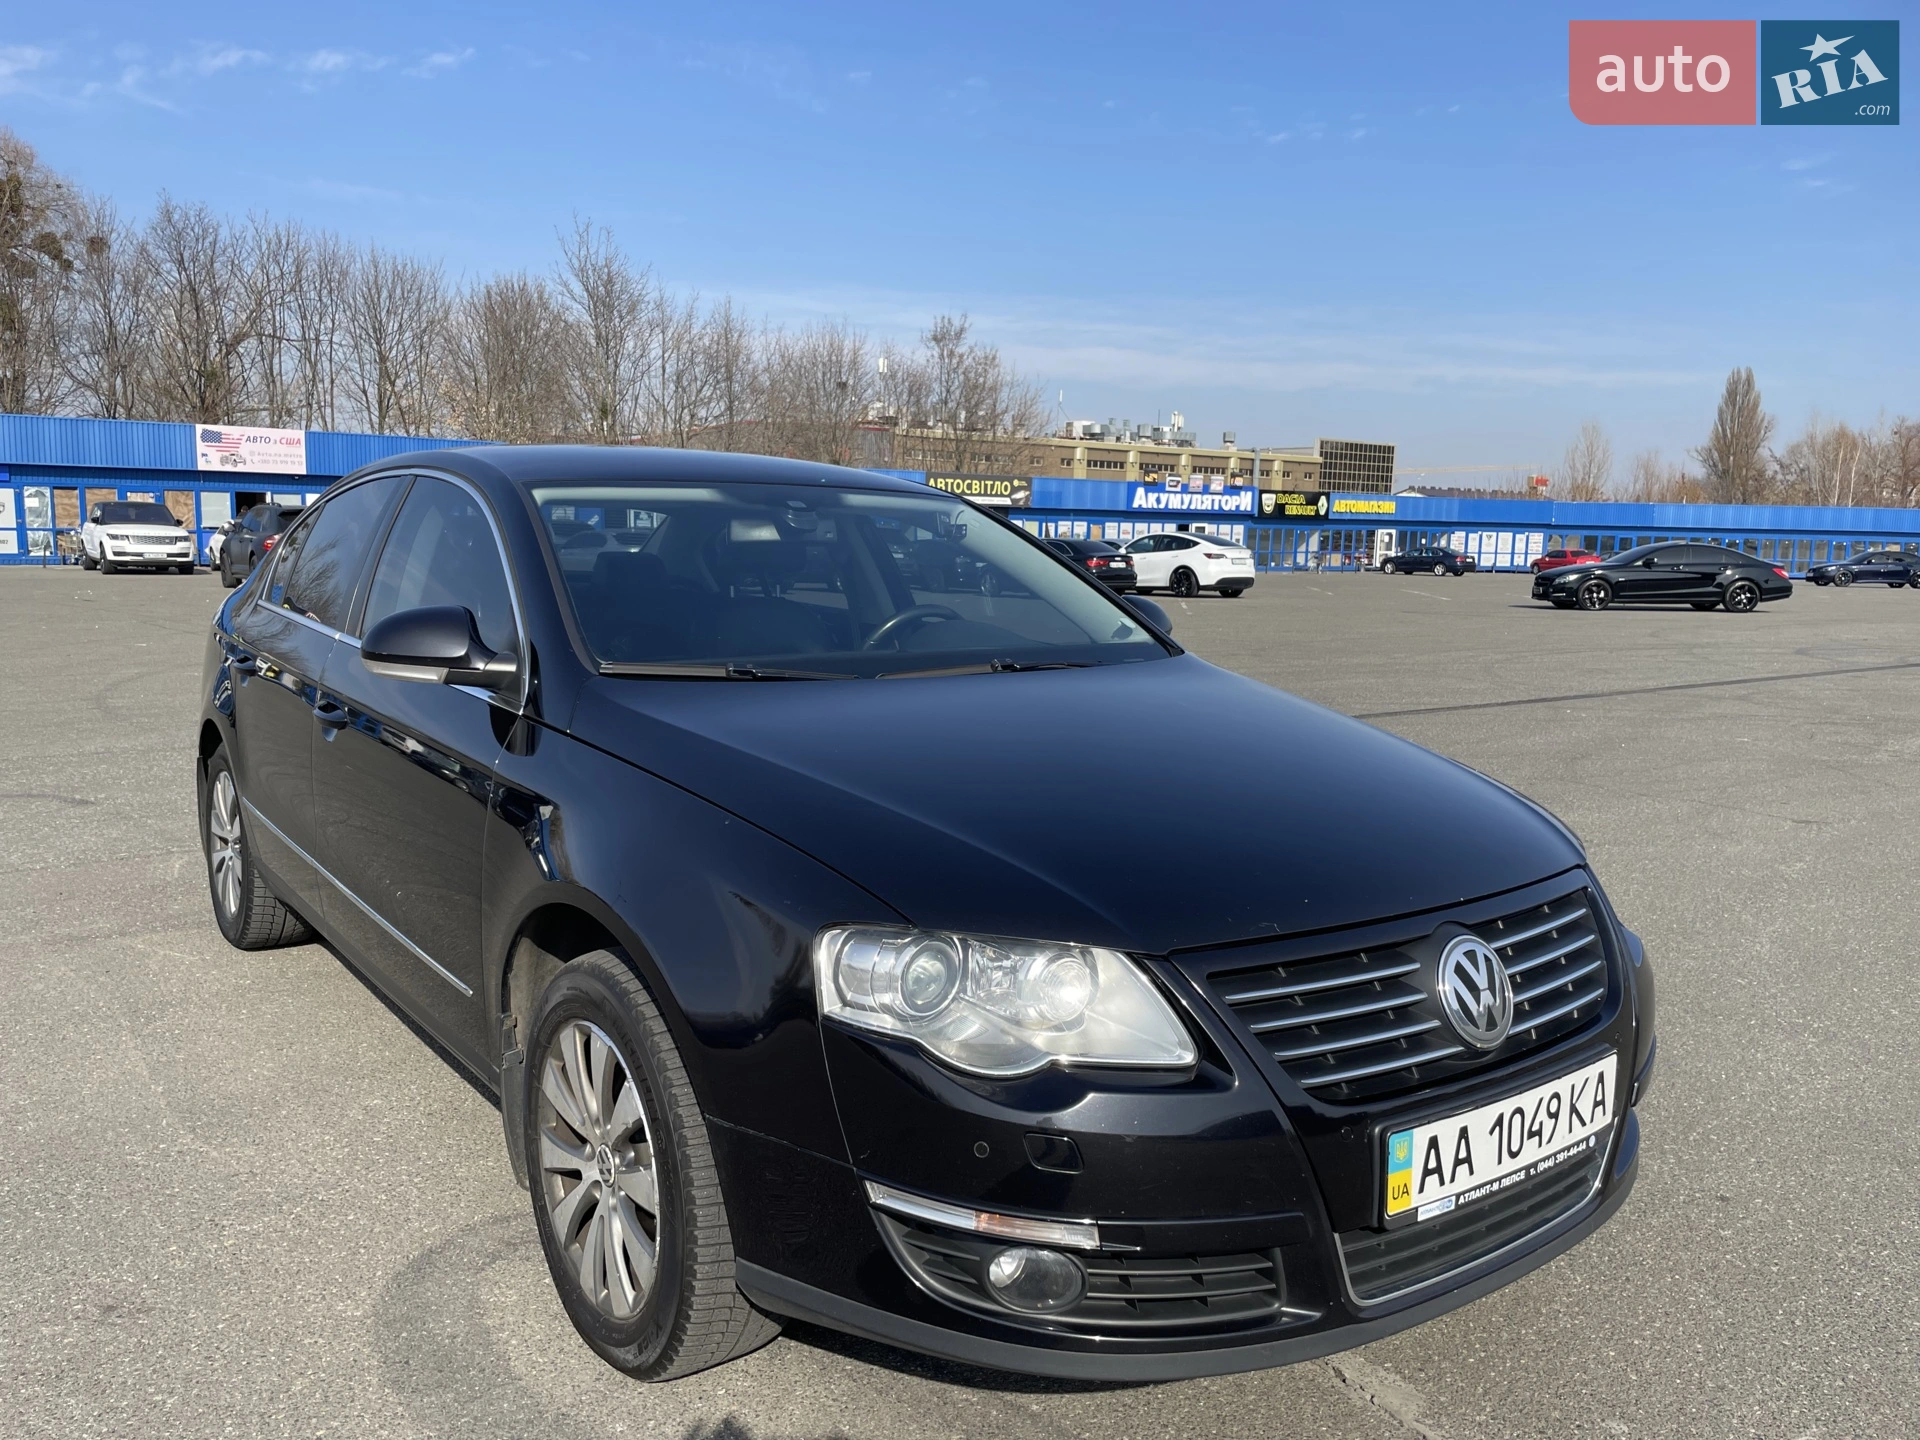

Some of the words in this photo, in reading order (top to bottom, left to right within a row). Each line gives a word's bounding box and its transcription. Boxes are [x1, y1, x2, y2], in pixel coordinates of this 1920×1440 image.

[245, 435, 271, 445] АВТО
[279, 436, 302, 446] США
[928, 477, 1011, 496] АВТОСВІТЛО
[1277, 493, 1306, 504] DACIA
[1333, 499, 1396, 514] АВТОМАГАЗИН
[1285, 505, 1317, 515] RENAULT
[1418, 1125, 1475, 1195] AA
[1488, 1091, 1562, 1166] 1049
[1566, 1070, 1607, 1135] KA
[1457, 1181, 1499, 1205] АТЛАНТ-М
[1500, 1171, 1526, 1192] ЛЕПСЕ
[1537, 1156, 1555, 1175] (044)
[1392, 1183, 1410, 1200] UA
